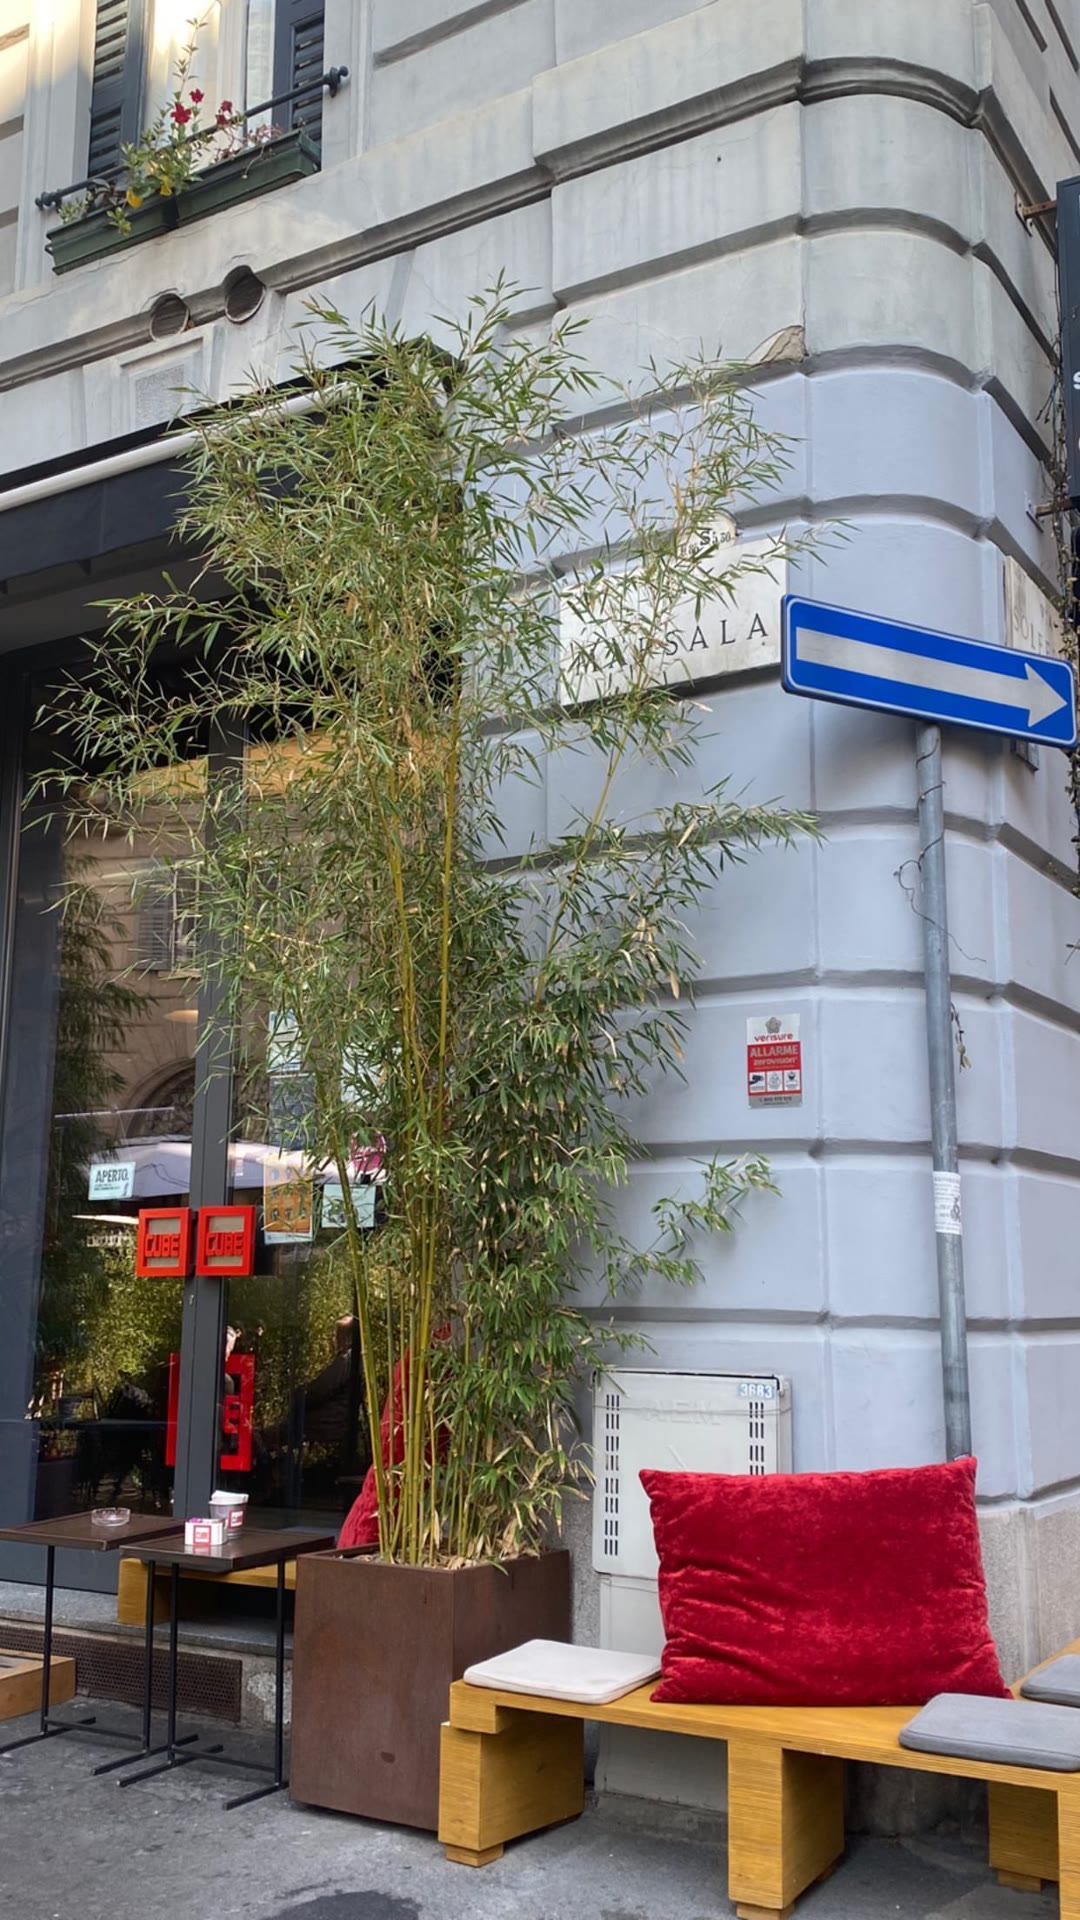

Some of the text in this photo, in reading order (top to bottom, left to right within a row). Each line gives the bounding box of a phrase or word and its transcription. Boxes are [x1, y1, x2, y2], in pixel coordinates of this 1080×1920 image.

[754, 1033, 793, 1042] verisure
[750, 1045, 798, 1057] ALLARME
[145, 1234, 180, 1257] CUBE
[206, 1231, 244, 1256] CUBE
